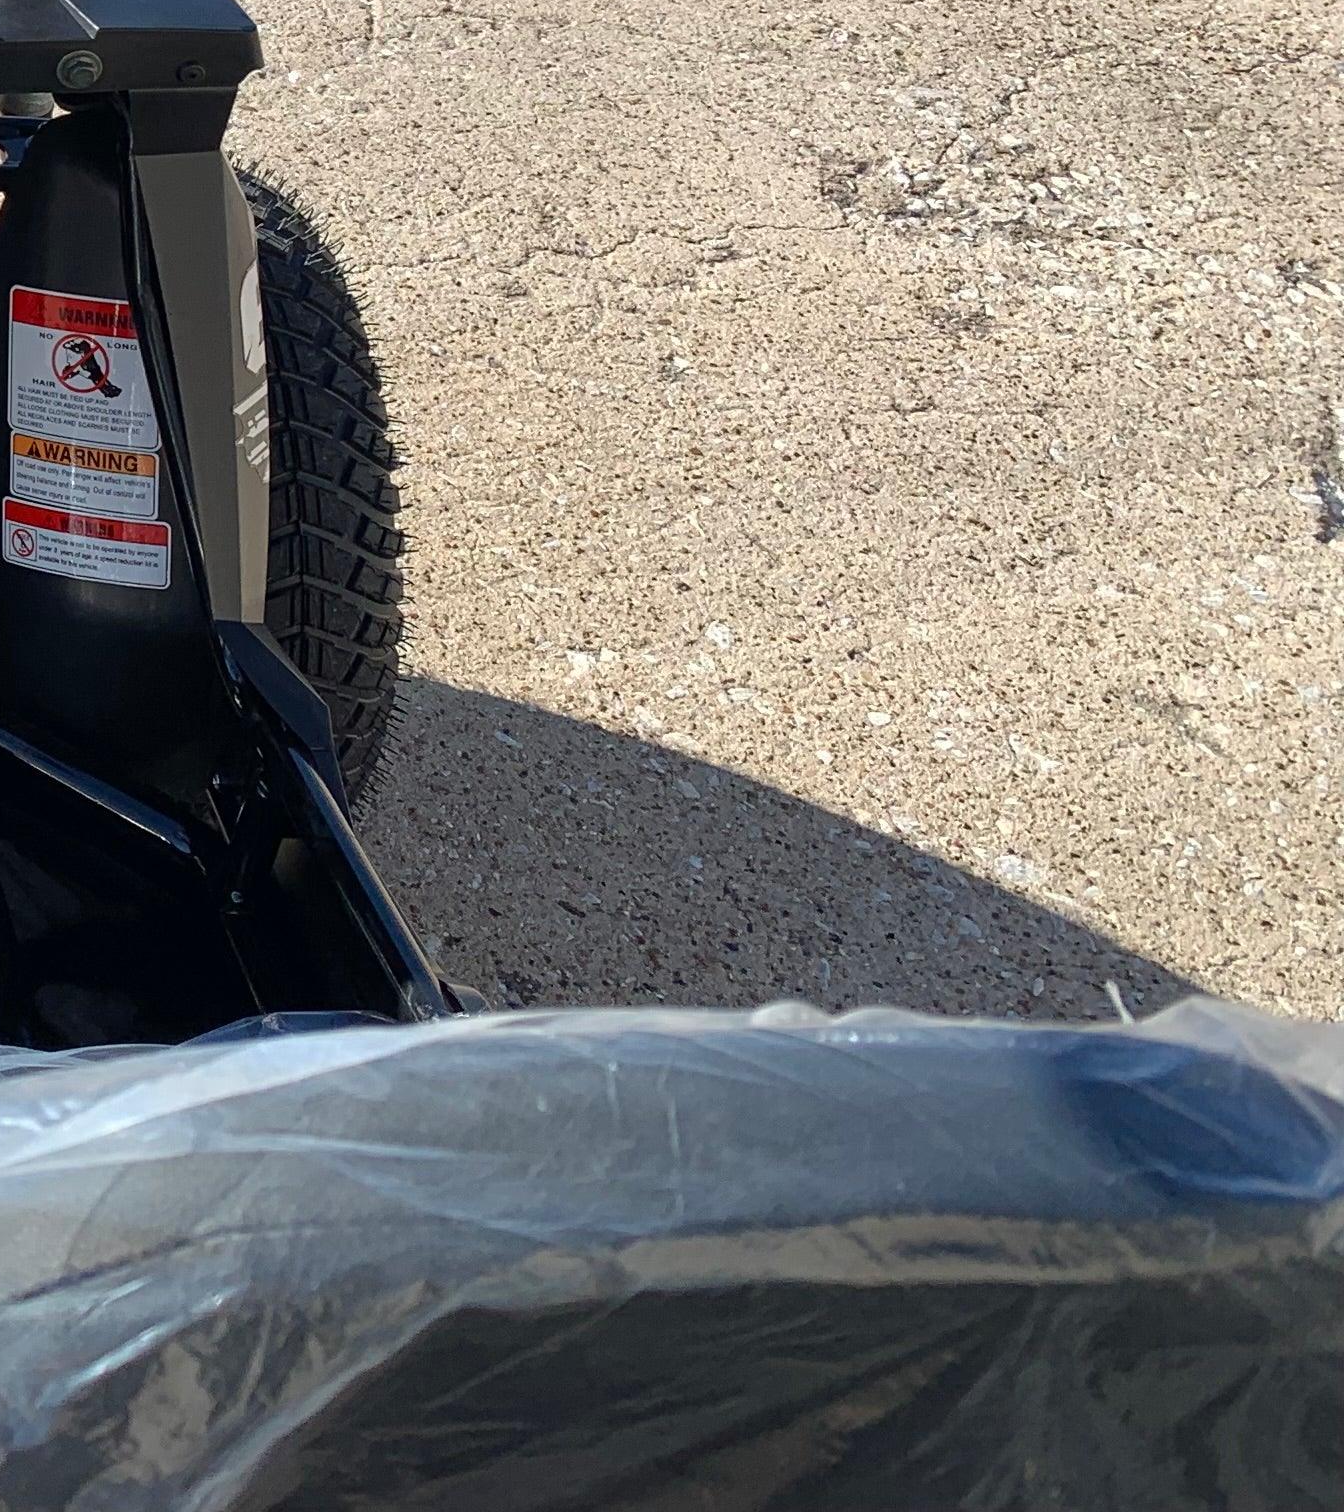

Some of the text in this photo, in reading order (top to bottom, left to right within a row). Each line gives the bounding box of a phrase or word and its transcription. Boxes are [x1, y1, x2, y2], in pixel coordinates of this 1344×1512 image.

[59, 308, 137, 331] WARNIN
[39, 332, 138, 352] NO LONG
[32, 377, 56, 389] HAIR
[43, 441, 138, 473] WARNING
